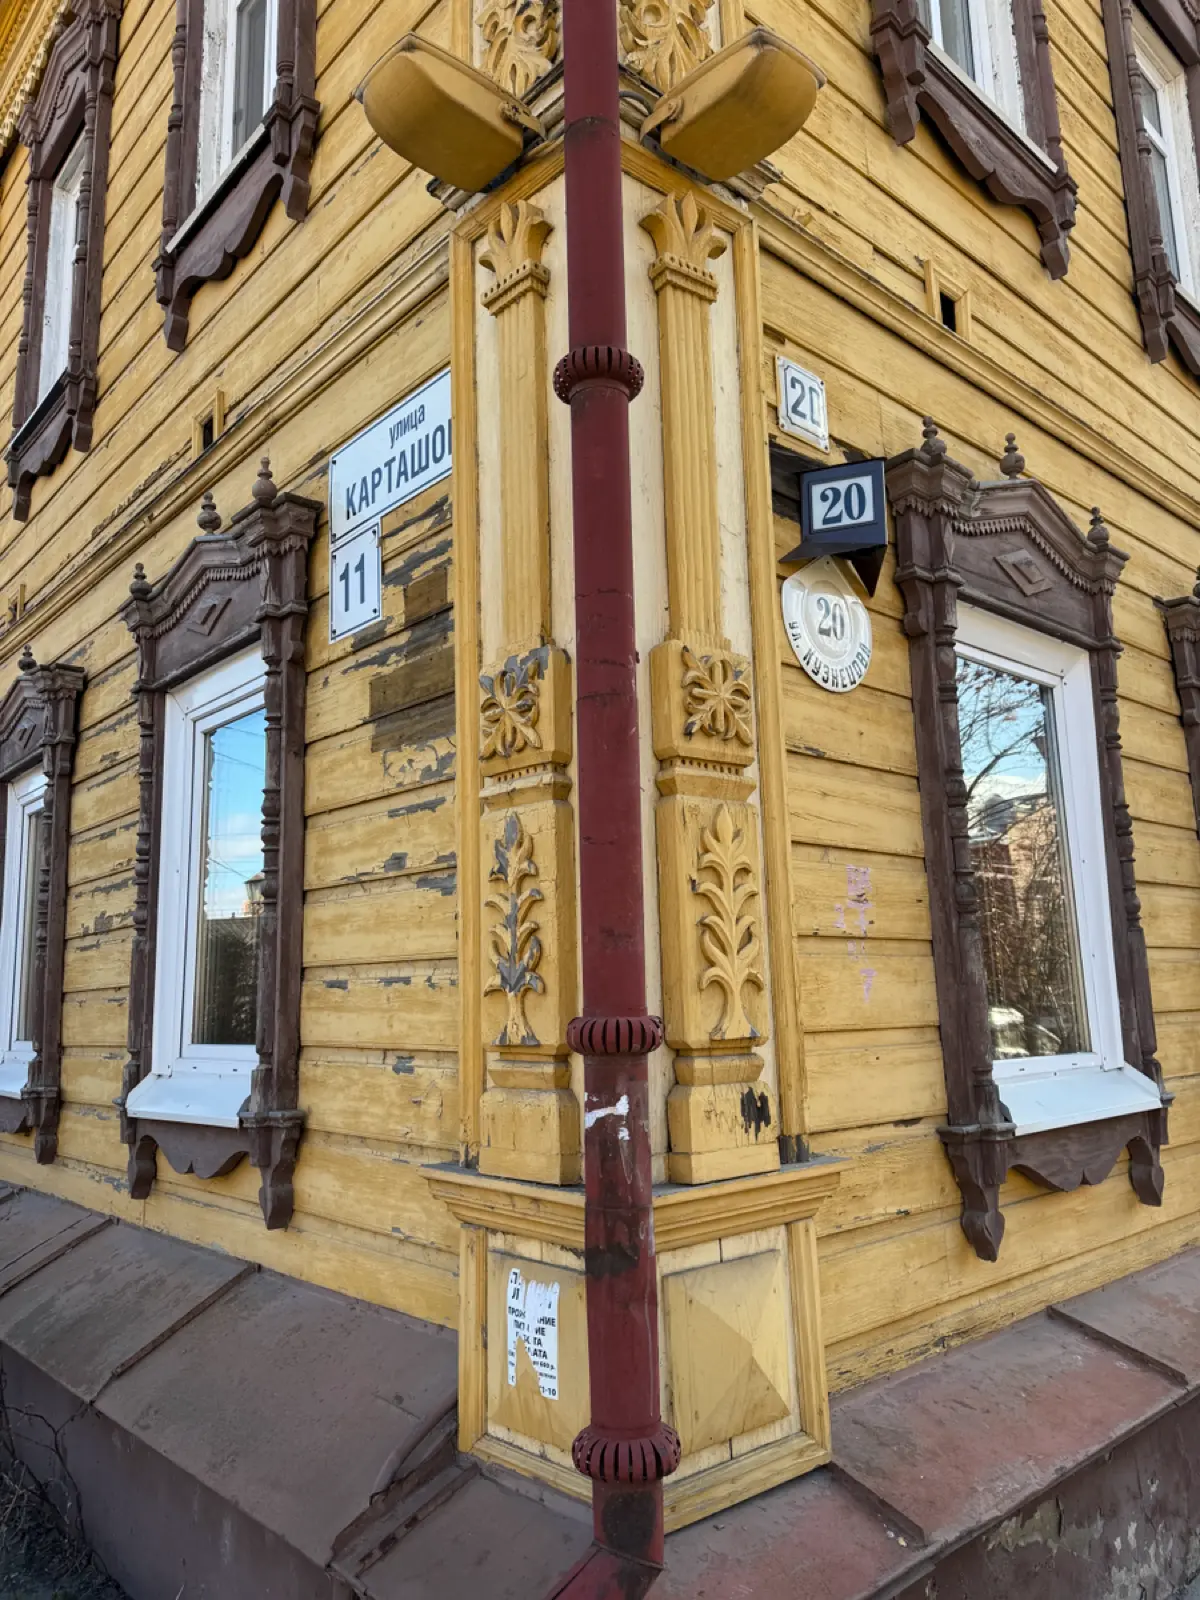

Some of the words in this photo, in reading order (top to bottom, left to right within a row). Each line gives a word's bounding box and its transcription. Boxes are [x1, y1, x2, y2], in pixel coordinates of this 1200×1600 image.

[388, 404, 425, 449] улица
[820, 483, 866, 526] 20
[339, 552, 366, 613] 11
[816, 596, 845, 641] 20
